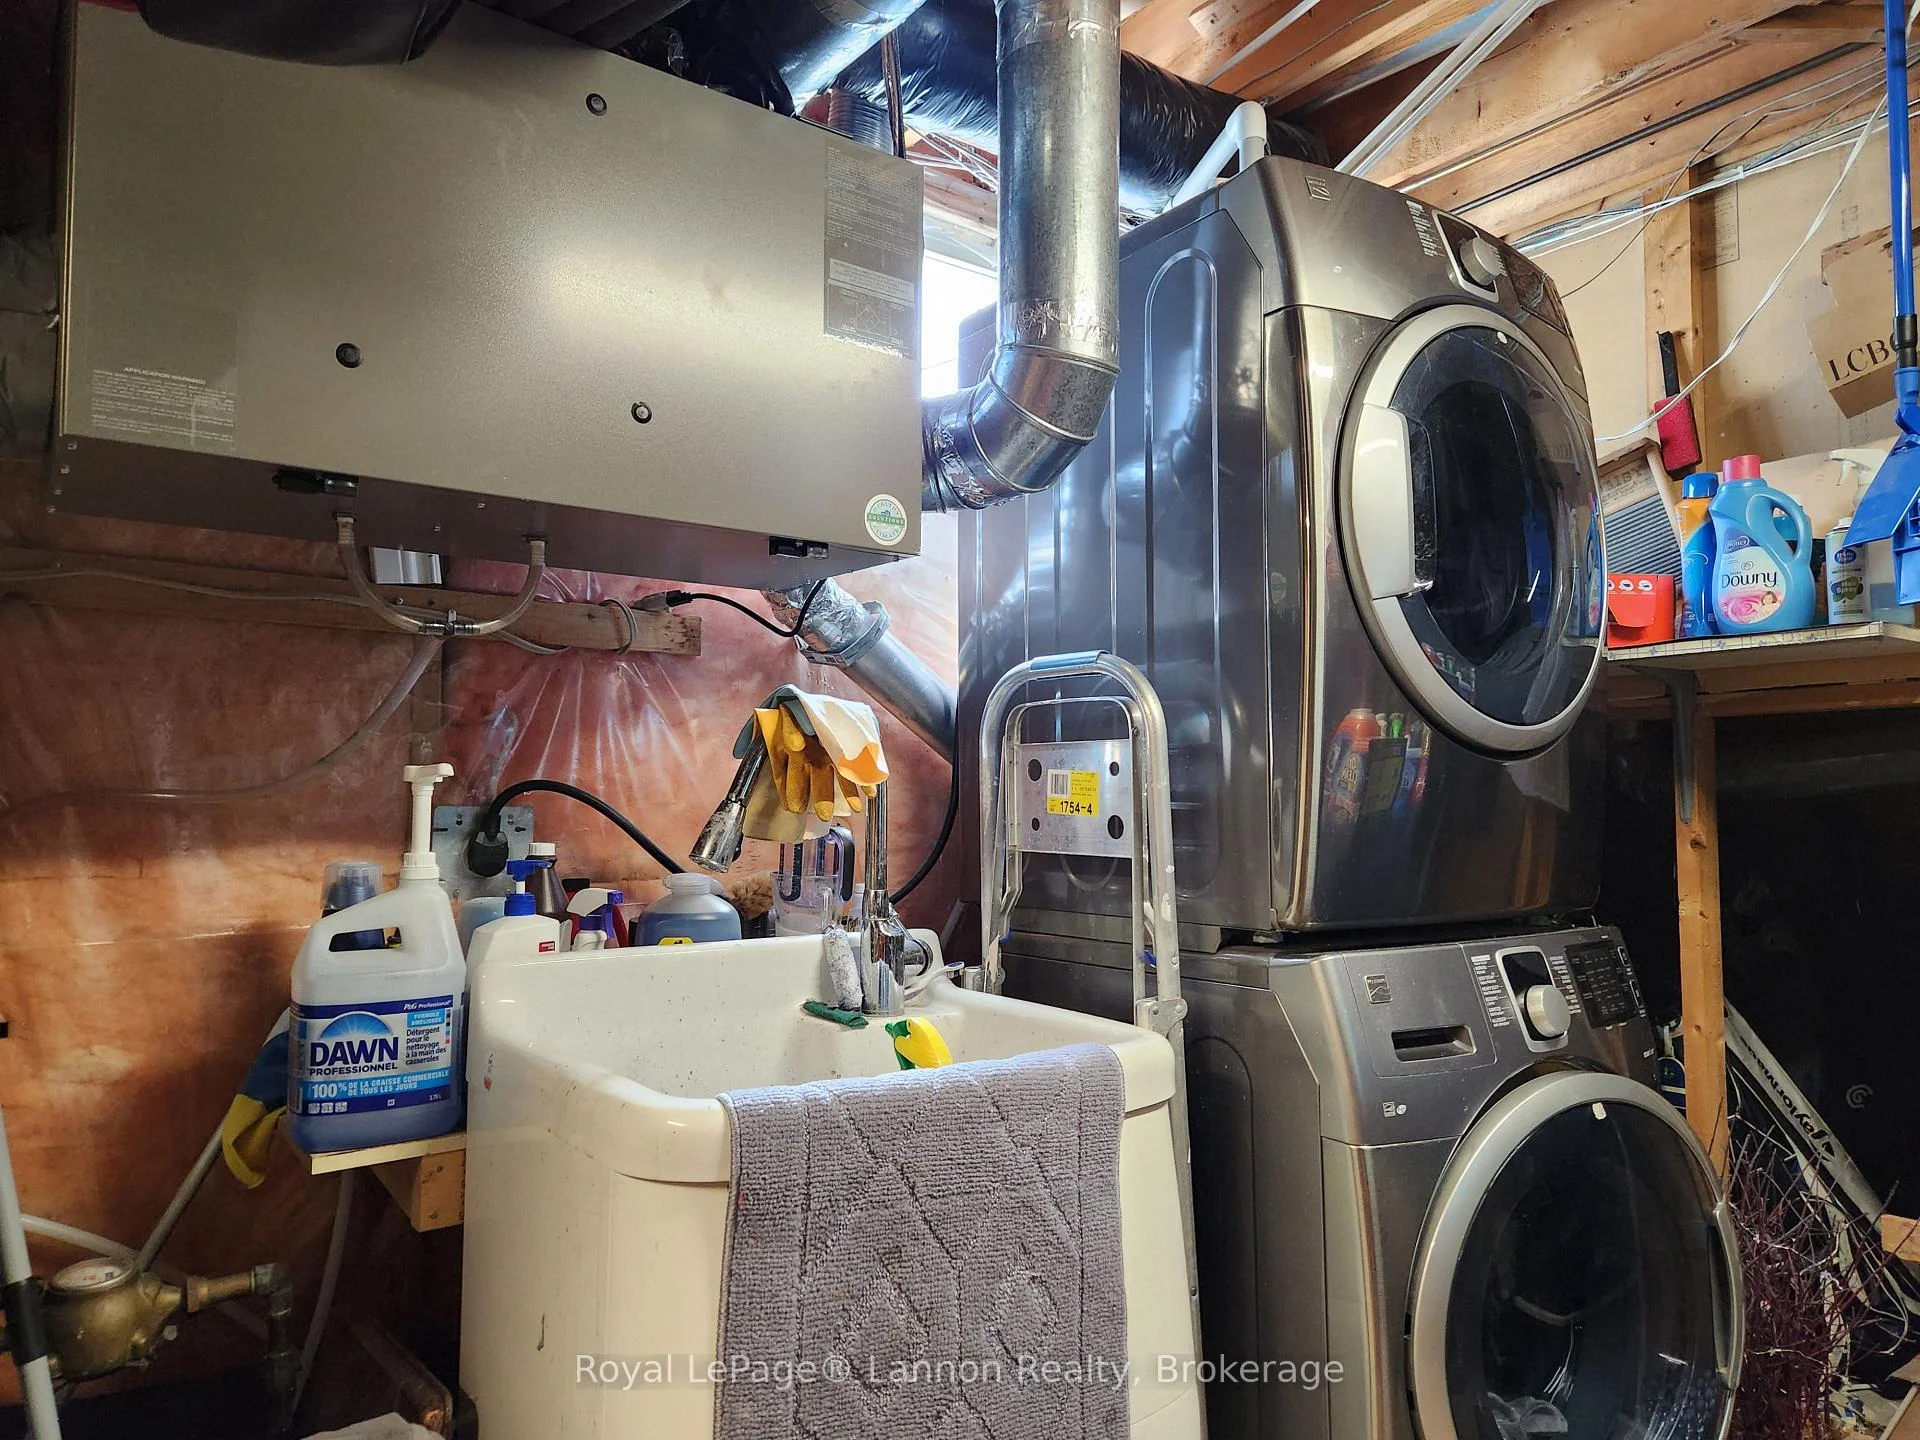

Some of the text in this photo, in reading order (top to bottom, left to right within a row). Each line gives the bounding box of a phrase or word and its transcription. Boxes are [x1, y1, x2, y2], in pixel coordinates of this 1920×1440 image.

[1828, 333, 1897, 382] LCB
[1721, 571, 1778, 588] Downy
[1060, 801, 1093, 815] 1754-4
[406, 1026, 440, 1036] Détergent
[405, 1041, 440, 1050] nettoyage
[406, 1037, 422, 1045] pour
[309, 1037, 399, 1067] DAWN
[418, 1049, 435, 1057] main
[405, 1056, 440, 1065] casseroles
[309, 1062, 398, 1076] PROFESSIONNEL
[371, 1077, 401, 1087] GRAISSE
[402, 1070, 449, 1083] COMMERCIALE
[347, 1082, 418, 1096] DE TOUS LES JOURS
